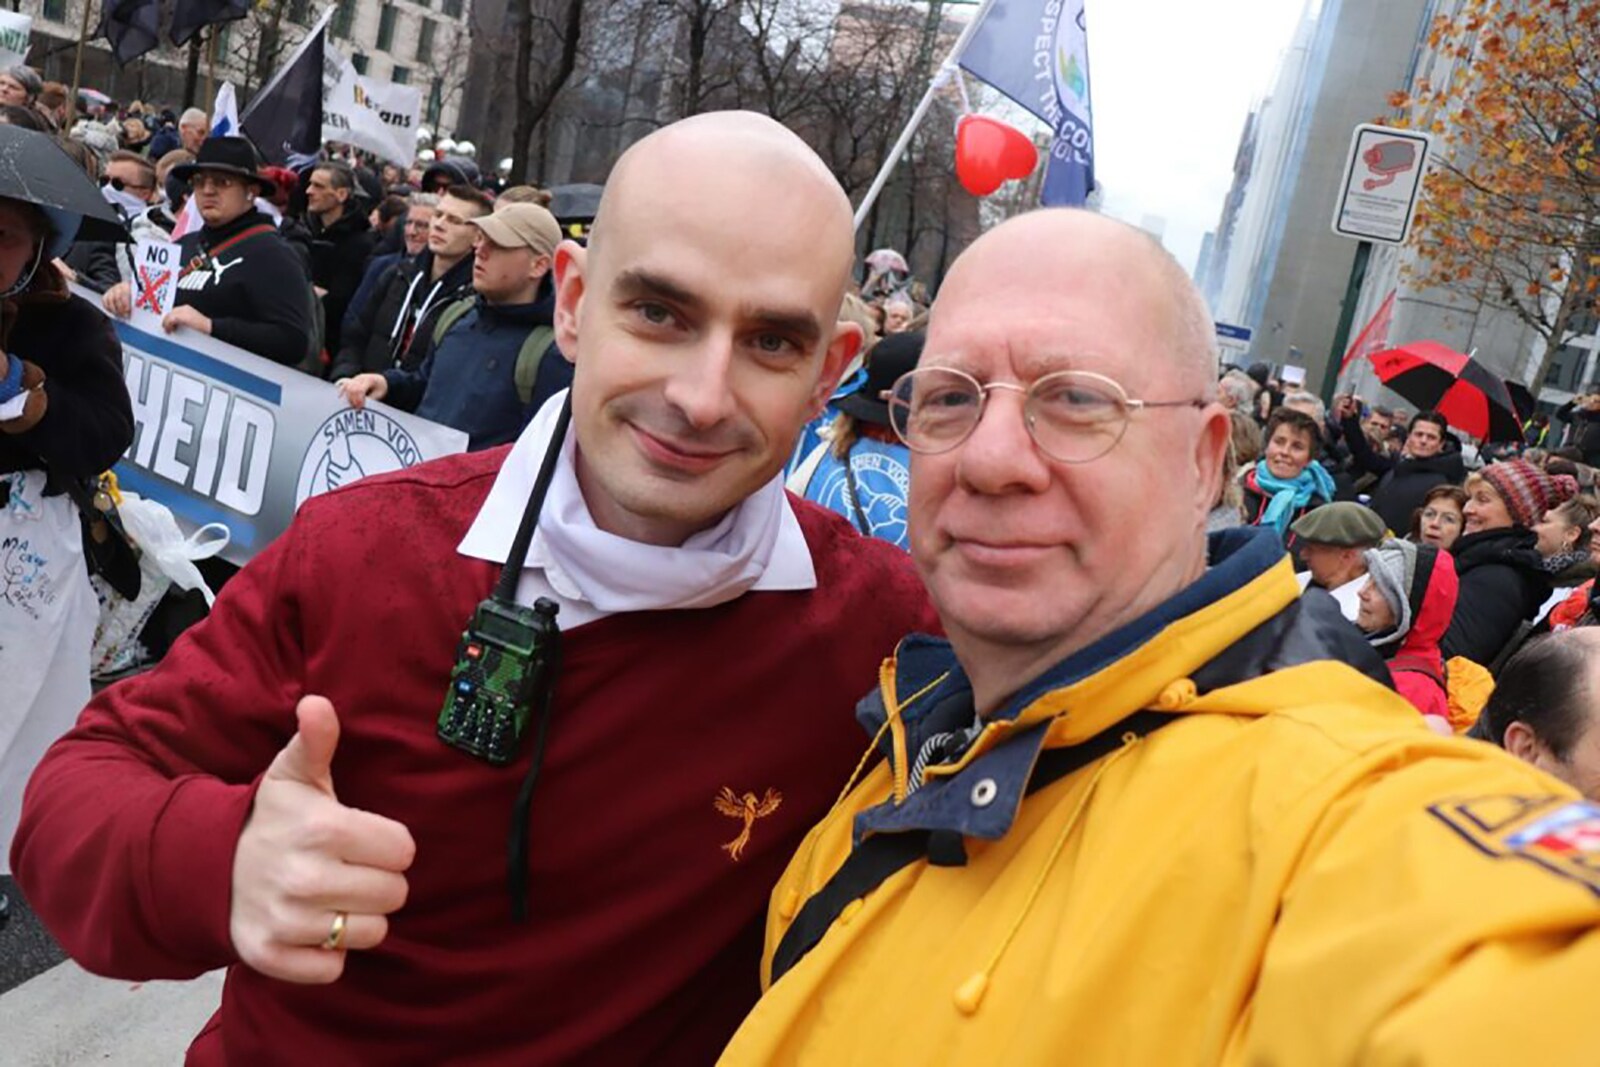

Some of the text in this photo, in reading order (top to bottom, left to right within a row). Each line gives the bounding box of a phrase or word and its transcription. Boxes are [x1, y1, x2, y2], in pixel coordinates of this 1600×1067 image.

[146, 245, 169, 264] NO
[122, 351, 276, 516] HEID
[324, 410, 376, 446] SAMEN
